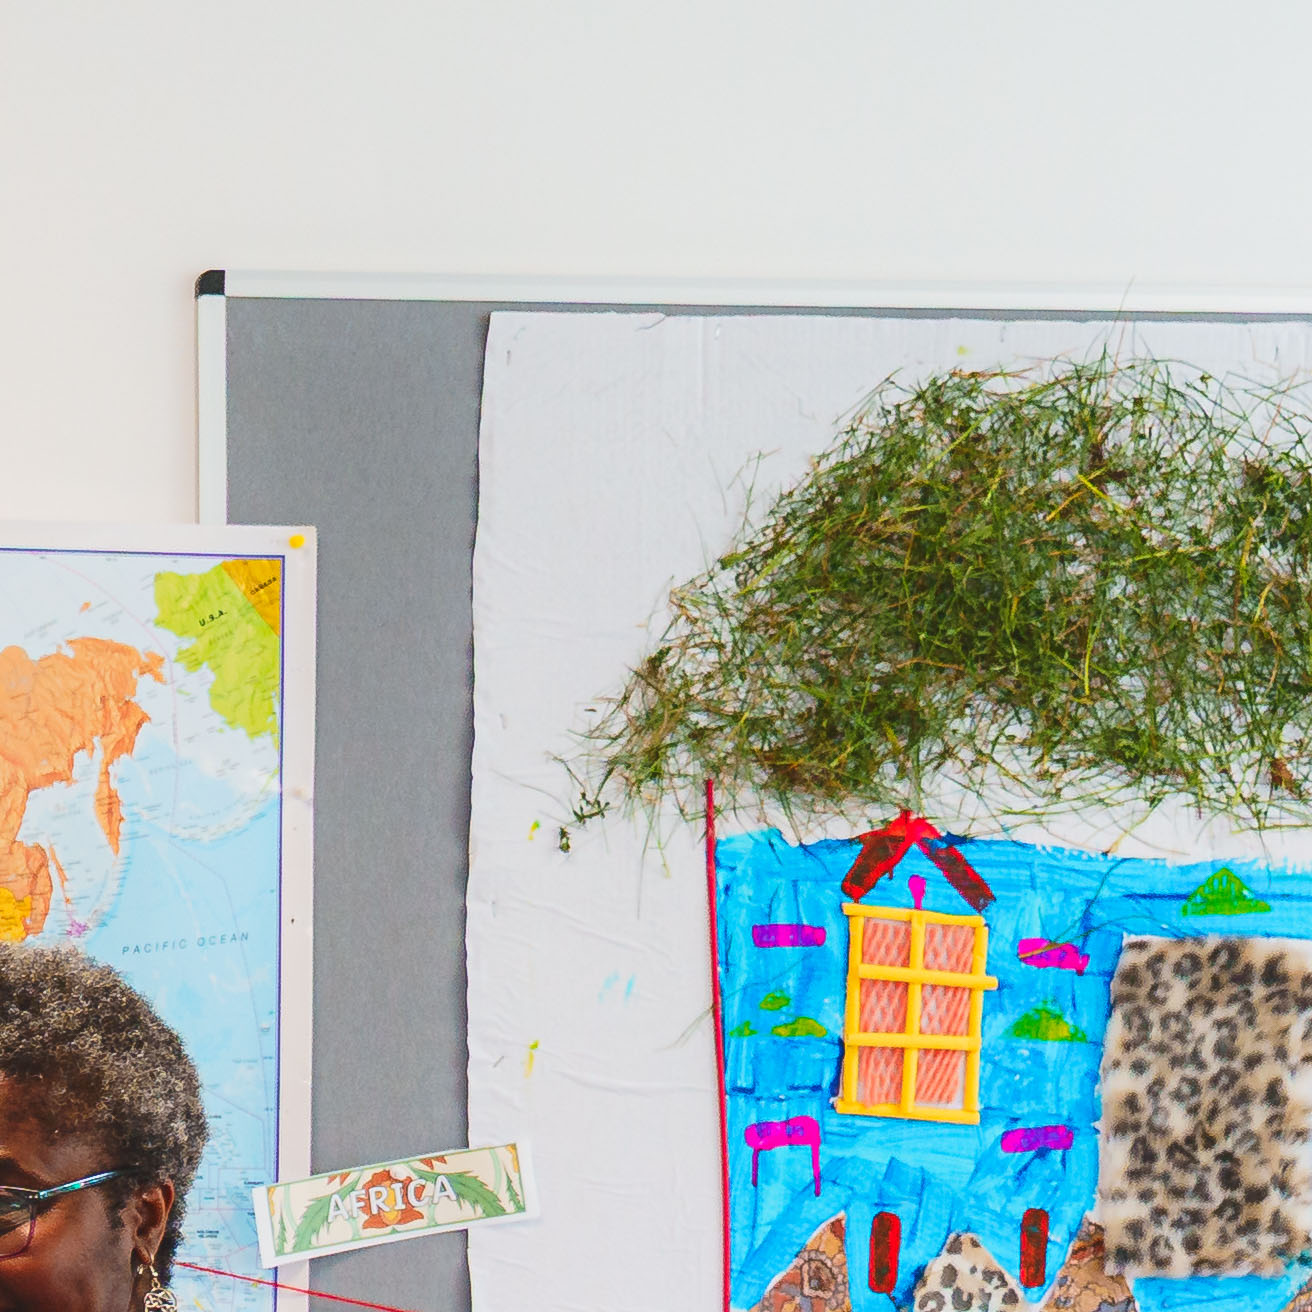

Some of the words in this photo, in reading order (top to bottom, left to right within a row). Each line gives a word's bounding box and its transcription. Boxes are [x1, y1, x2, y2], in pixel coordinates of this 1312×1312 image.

[121, 938, 188, 957] PACIFIC
[196, 932, 250, 948] OCEAN
[327, 1175, 458, 1224] AFRICA
